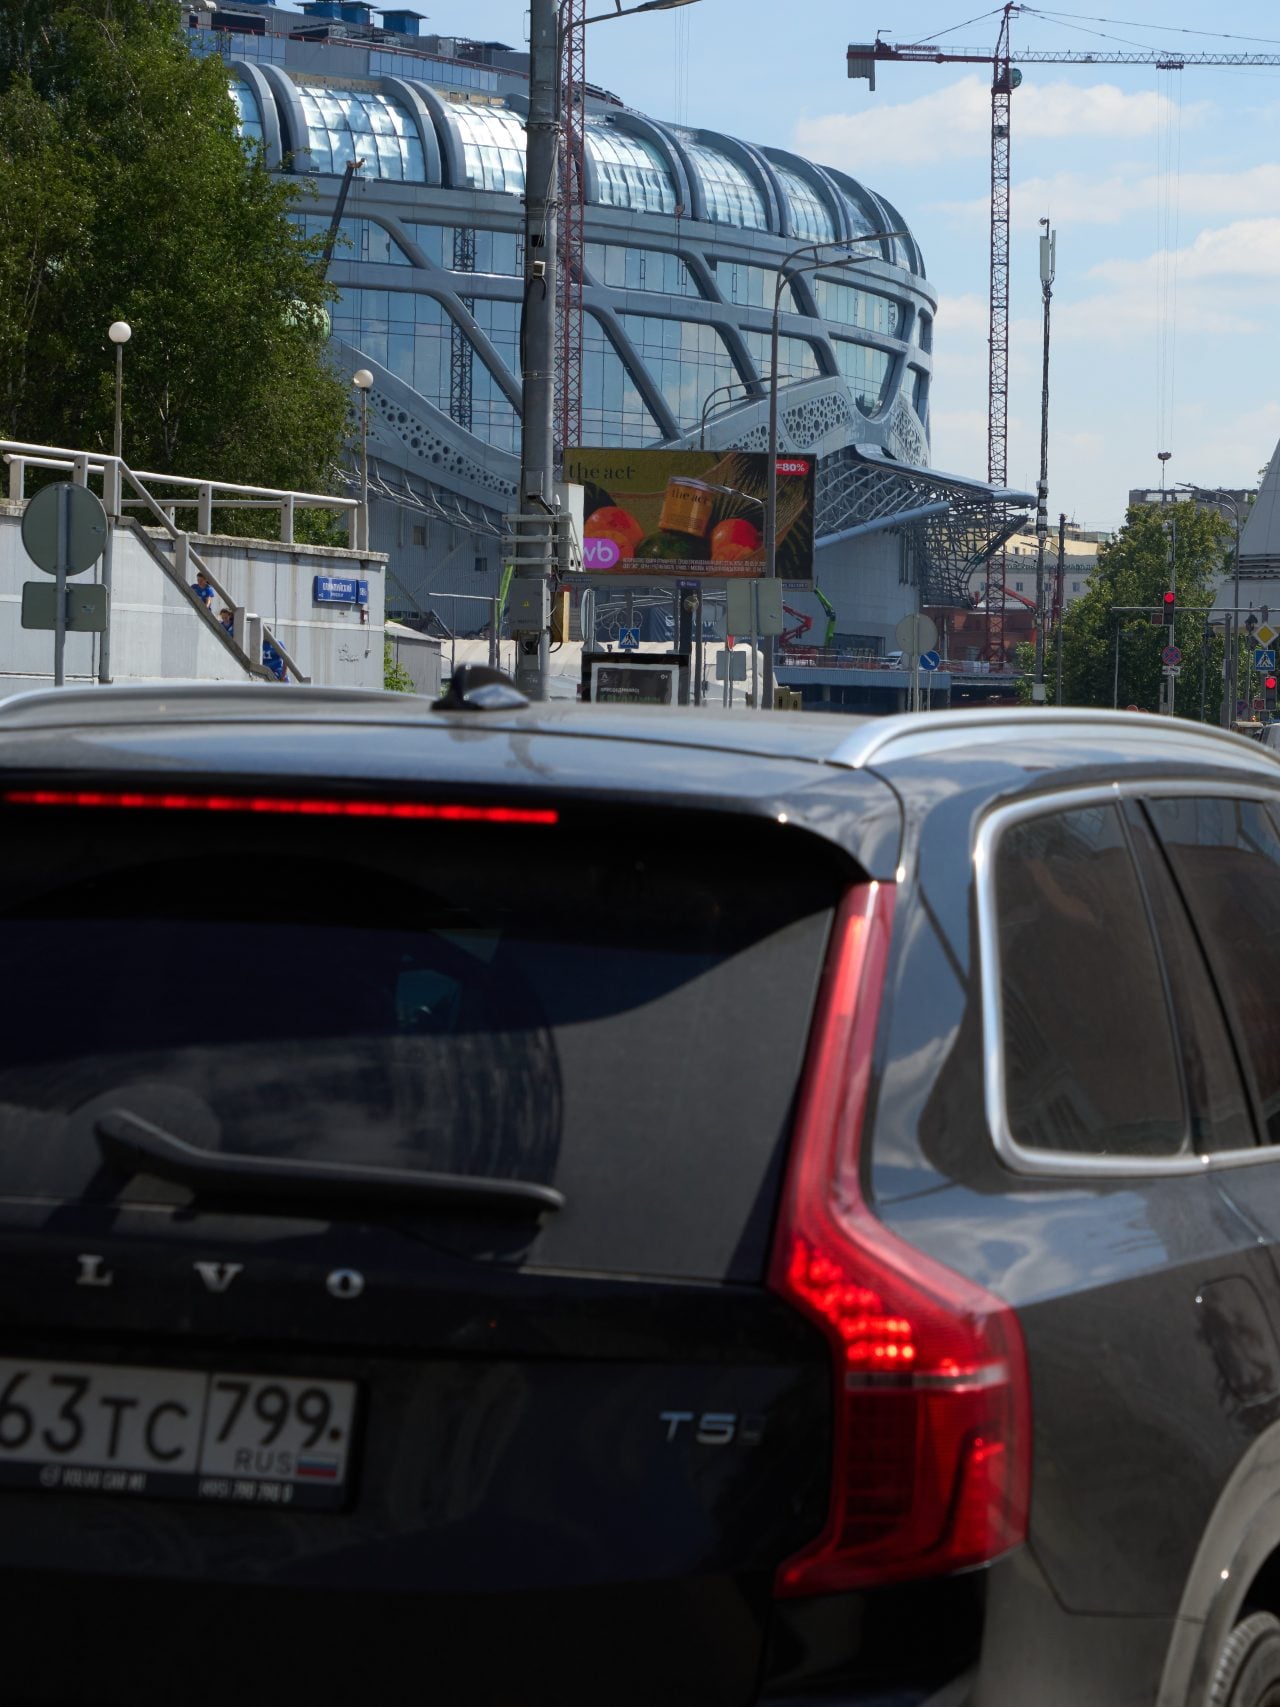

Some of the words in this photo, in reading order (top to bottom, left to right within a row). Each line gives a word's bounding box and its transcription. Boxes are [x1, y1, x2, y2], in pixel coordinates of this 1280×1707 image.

[569, 462, 600, 481] the
[603, 465, 636, 480] act
[671, 488, 690, 501] the
[660, 1410, 736, 1445] T5
[234, 1449, 293, 1475] RUS
